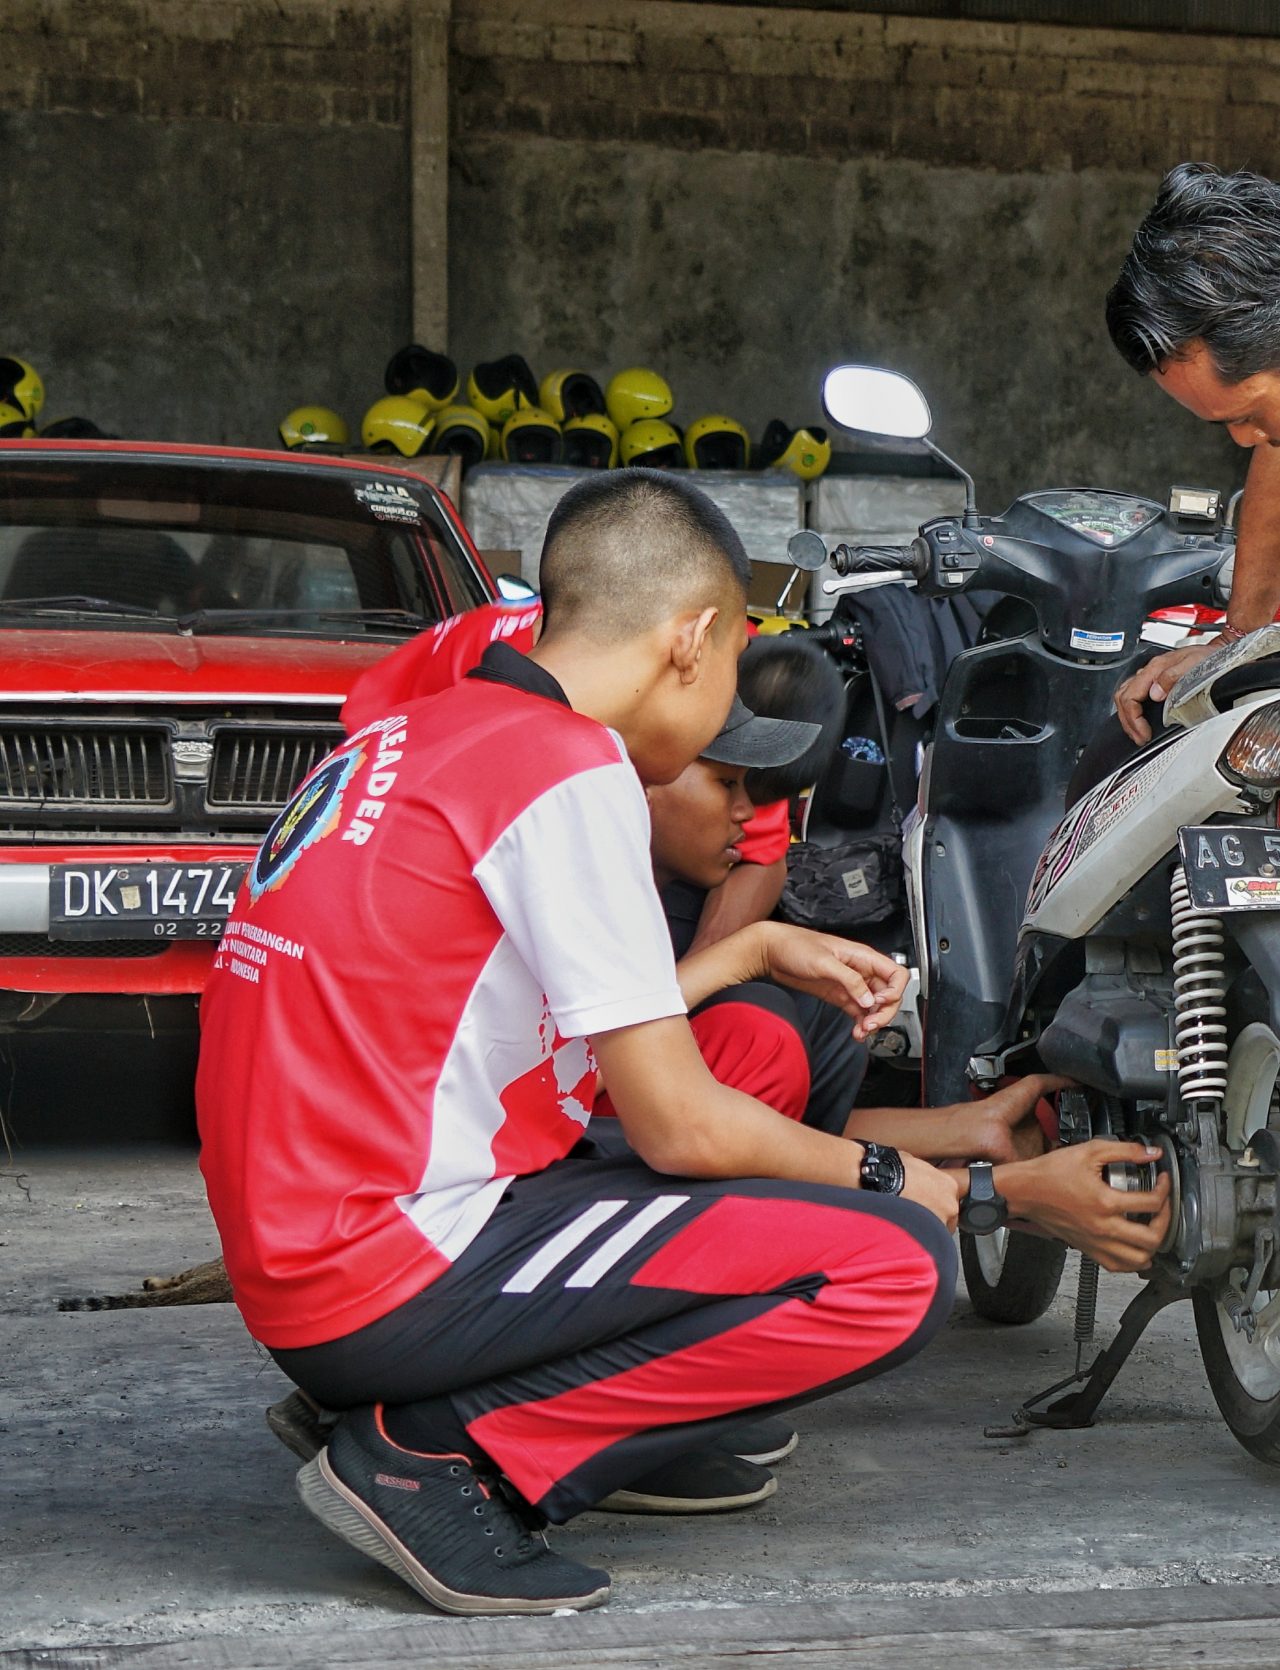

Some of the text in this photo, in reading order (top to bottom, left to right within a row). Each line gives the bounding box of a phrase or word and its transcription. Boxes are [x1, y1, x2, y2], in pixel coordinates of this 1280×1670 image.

[1197, 834, 1246, 869] AG
[64, 868, 237, 917] DK 1474
[153, 922, 178, 936] 02
[195, 922, 222, 936] 22
